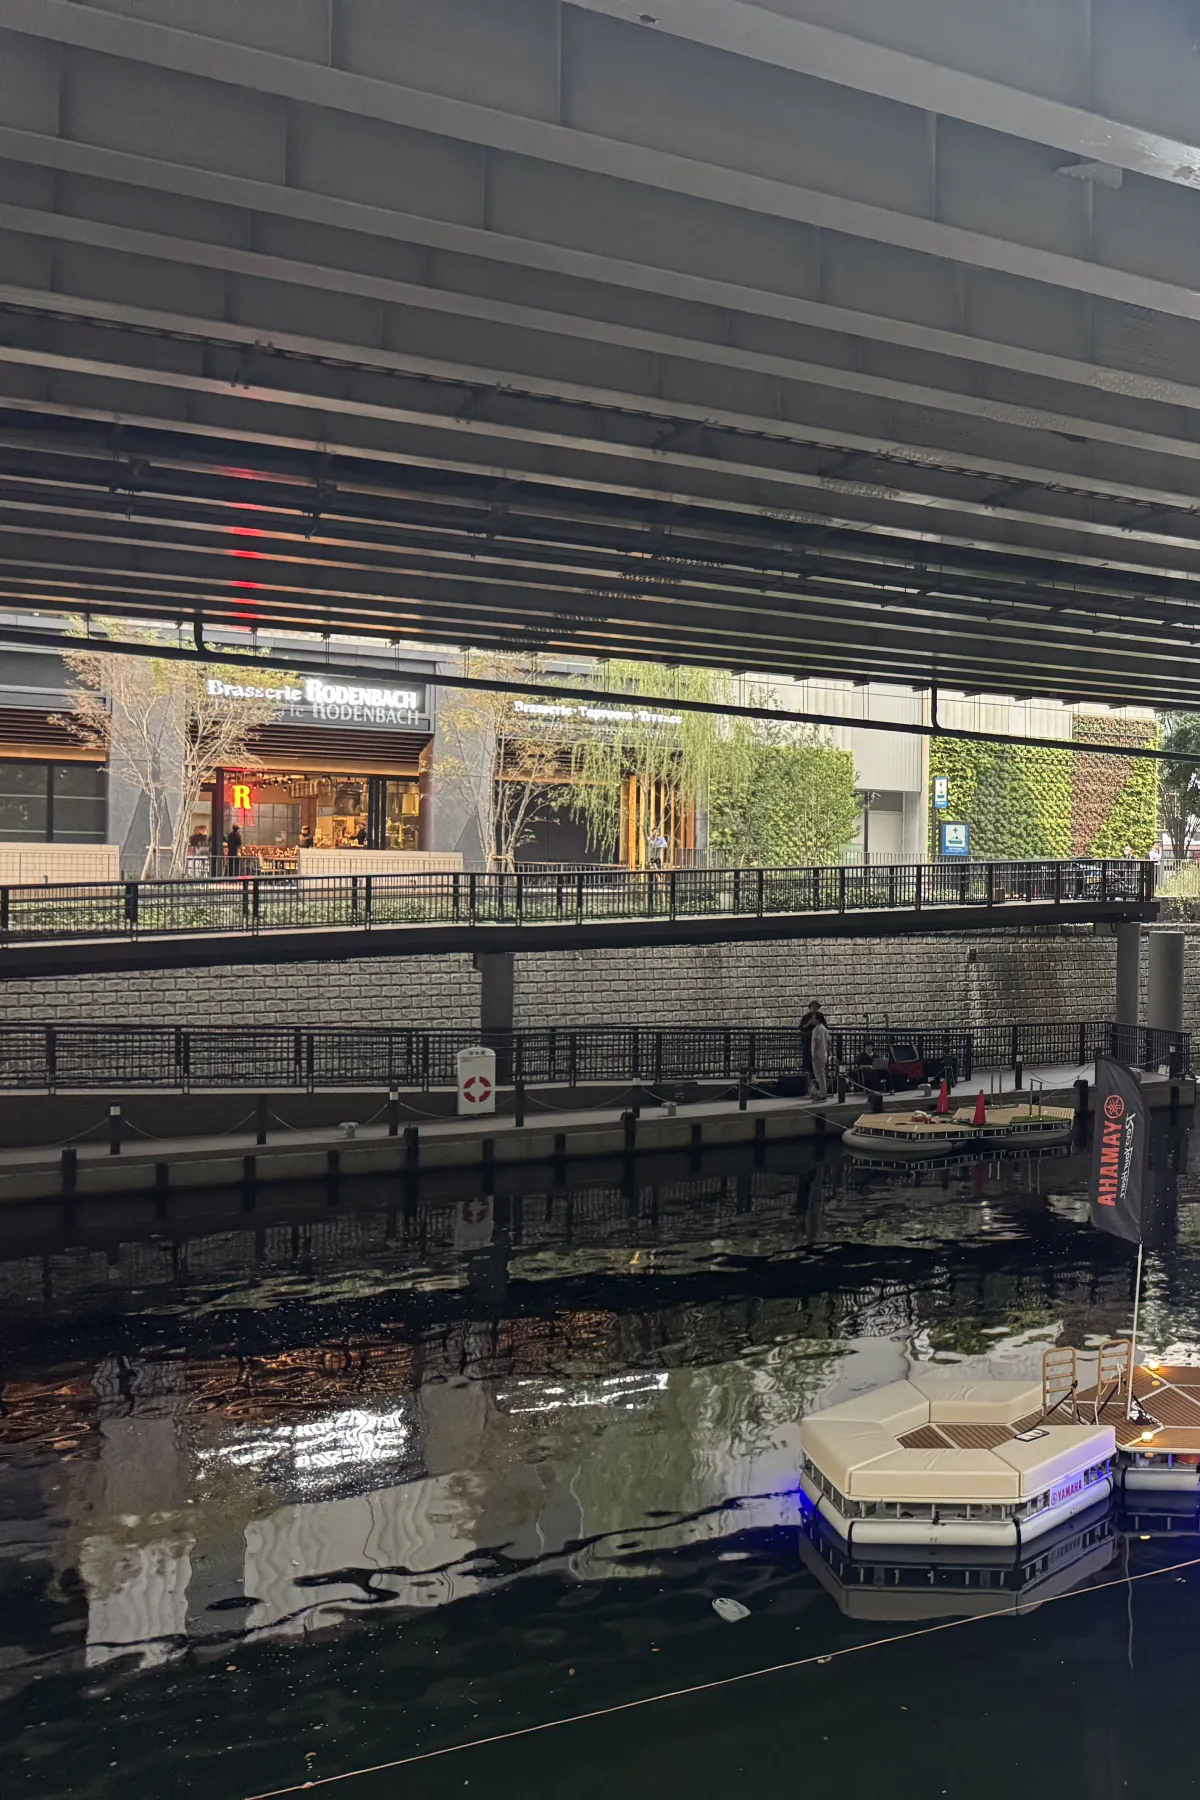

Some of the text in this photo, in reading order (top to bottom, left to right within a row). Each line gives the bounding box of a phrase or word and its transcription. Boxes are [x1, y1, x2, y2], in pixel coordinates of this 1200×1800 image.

[207, 679, 417, 709] Brasserie RODENBACH
[232, 784, 252, 810] R
[1057, 1479, 1082, 1501] YAMAHA
